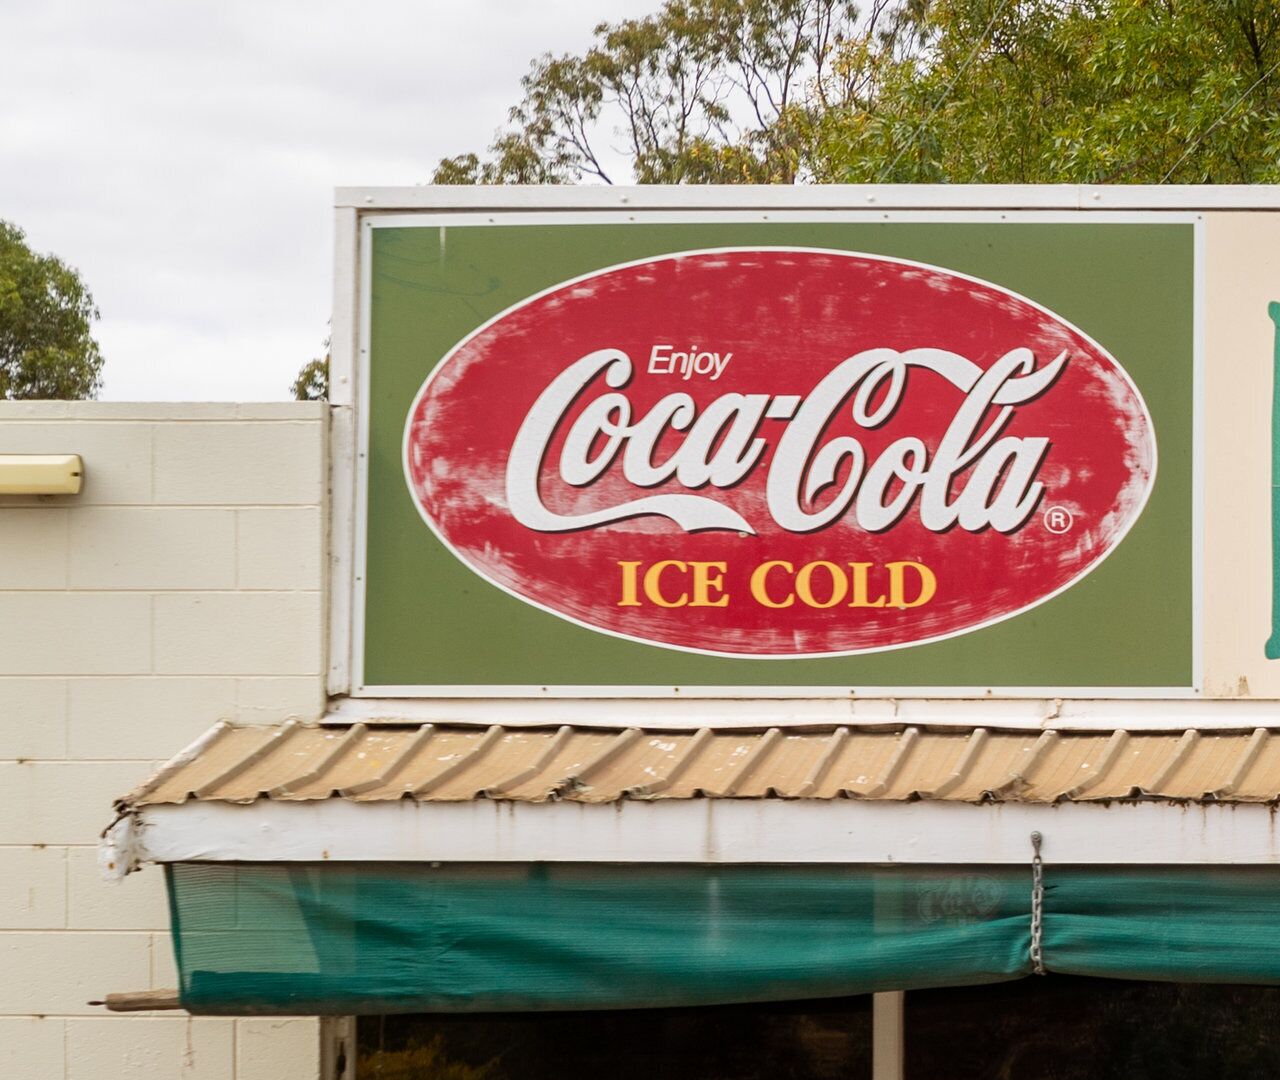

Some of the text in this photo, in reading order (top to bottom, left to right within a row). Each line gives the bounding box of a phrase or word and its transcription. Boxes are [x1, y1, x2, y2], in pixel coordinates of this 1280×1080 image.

[647, 344, 733, 381] Enjoy
[506, 347, 1069, 535] Coca-Cola
[617, 560, 938, 610] ICE COLD
